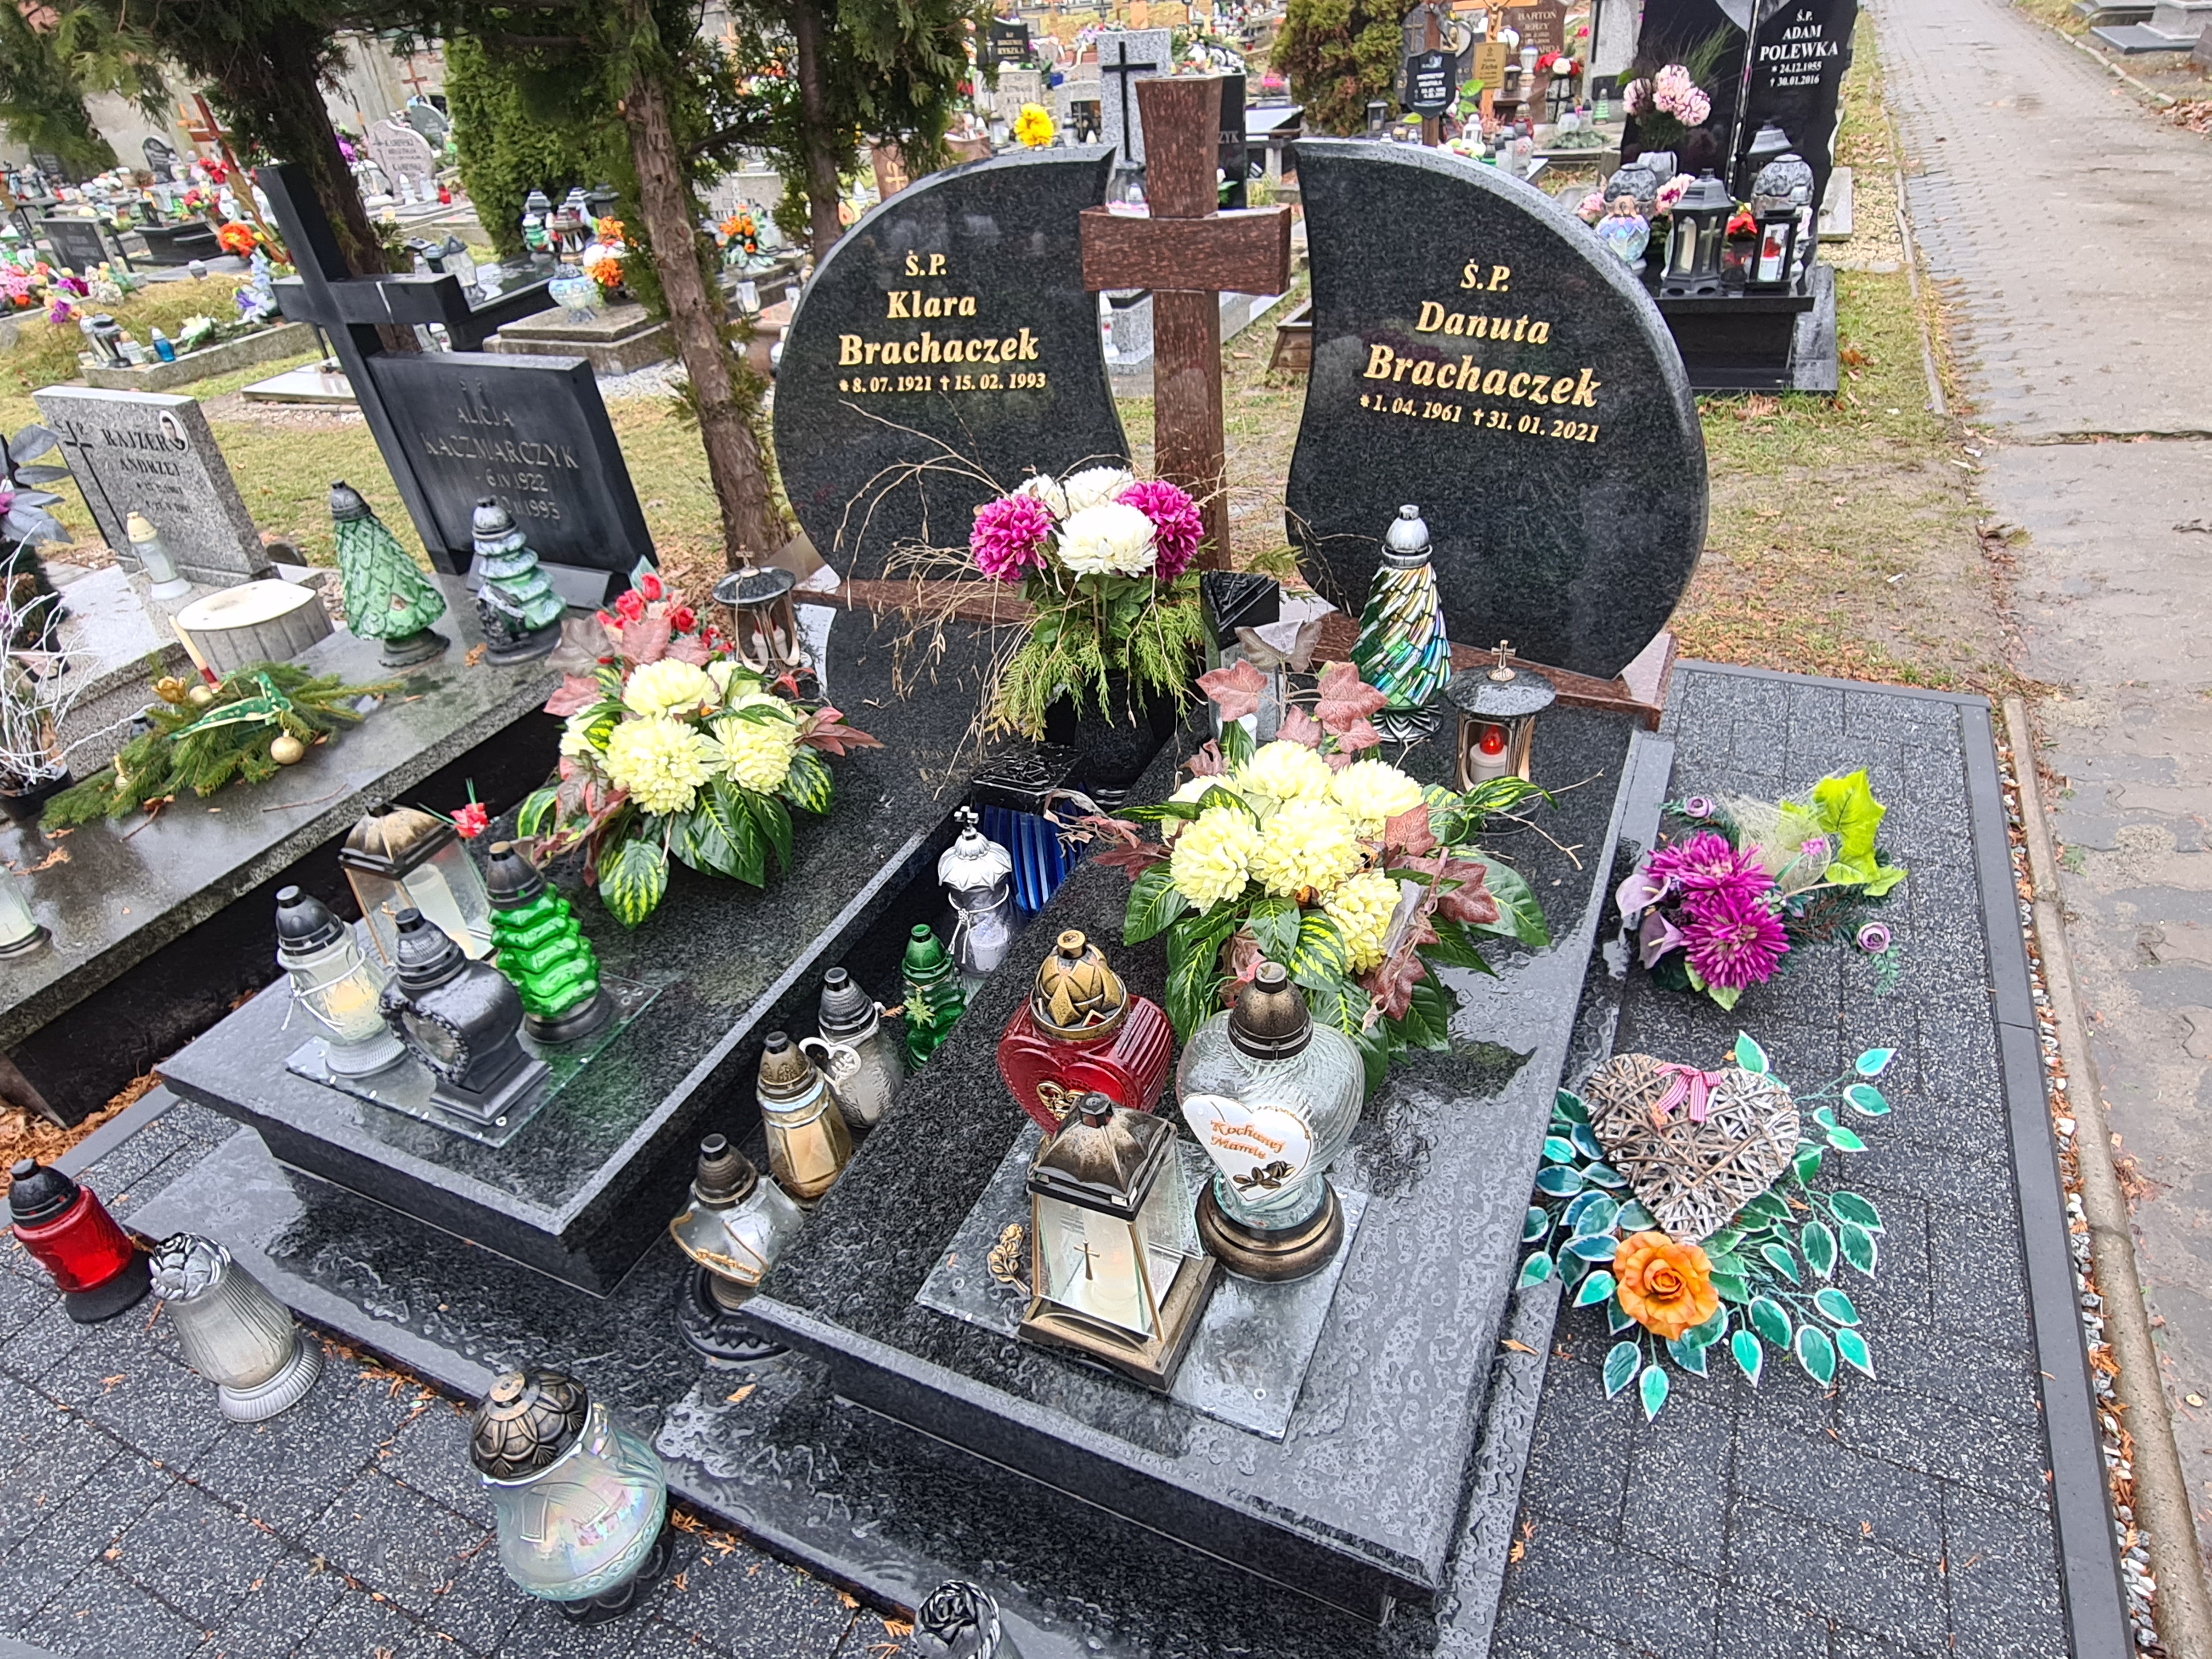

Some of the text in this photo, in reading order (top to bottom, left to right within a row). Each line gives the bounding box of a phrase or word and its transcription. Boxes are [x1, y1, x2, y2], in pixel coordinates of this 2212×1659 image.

[1782, 25, 1822, 40] ADAM
[1759, 41, 1838, 61] POLEWKA
[1777, 74, 1820, 86] 30.01.2016
[1779, 61, 1822, 74] 24.12.1955
[887, 290, 977, 319] Klara
[1415, 300, 1550, 345] Danuta
[838, 327, 1039, 366] Brachaczek
[1363, 343, 1601, 408] Brachaczek
[101, 428, 173, 453] RAJZER
[420, 432, 579, 469] KACZMARCZYK
[120, 458, 181, 477] ANDRZEJ
[1210, 1119, 1286, 1154] Kochanej
[1210, 1135, 1267, 1159] Mamie
